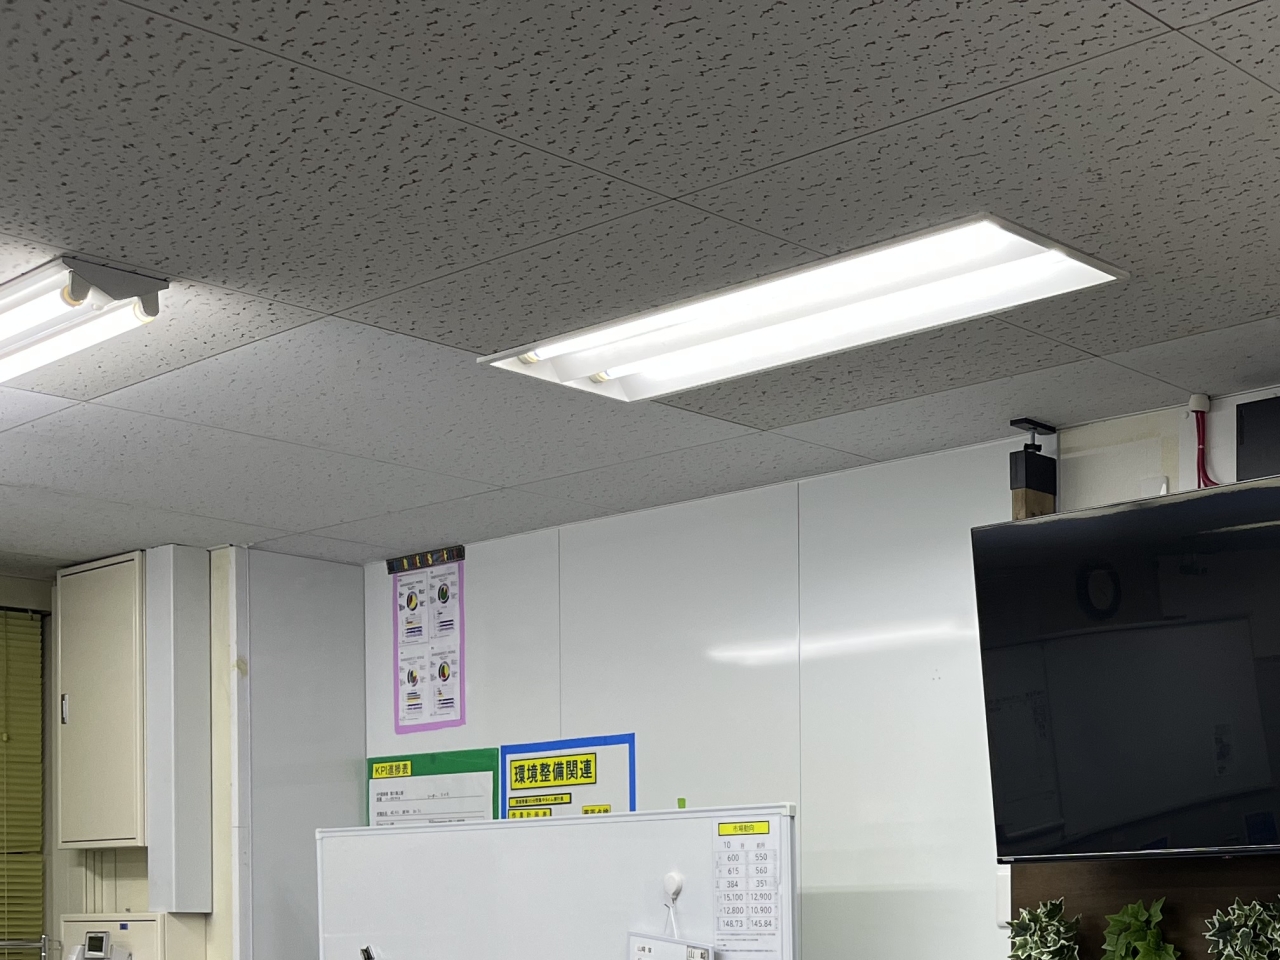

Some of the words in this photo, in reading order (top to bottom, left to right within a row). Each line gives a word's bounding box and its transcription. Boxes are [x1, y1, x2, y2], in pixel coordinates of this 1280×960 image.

[375, 763, 409, 776] KPI進捗表
[513, 758, 593, 785] 環境整備関連
[723, 841, 731, 849] 10
[727, 853, 740, 861] 600
[755, 853, 768, 861] 550
[727, 866, 739, 875] 615
[755, 866, 768, 874] 560
[726, 880, 739, 888] 384
[755, 879, 767, 888] 351
[722, 919, 743, 928] 148.73
[751, 919, 772, 928] 145.84
